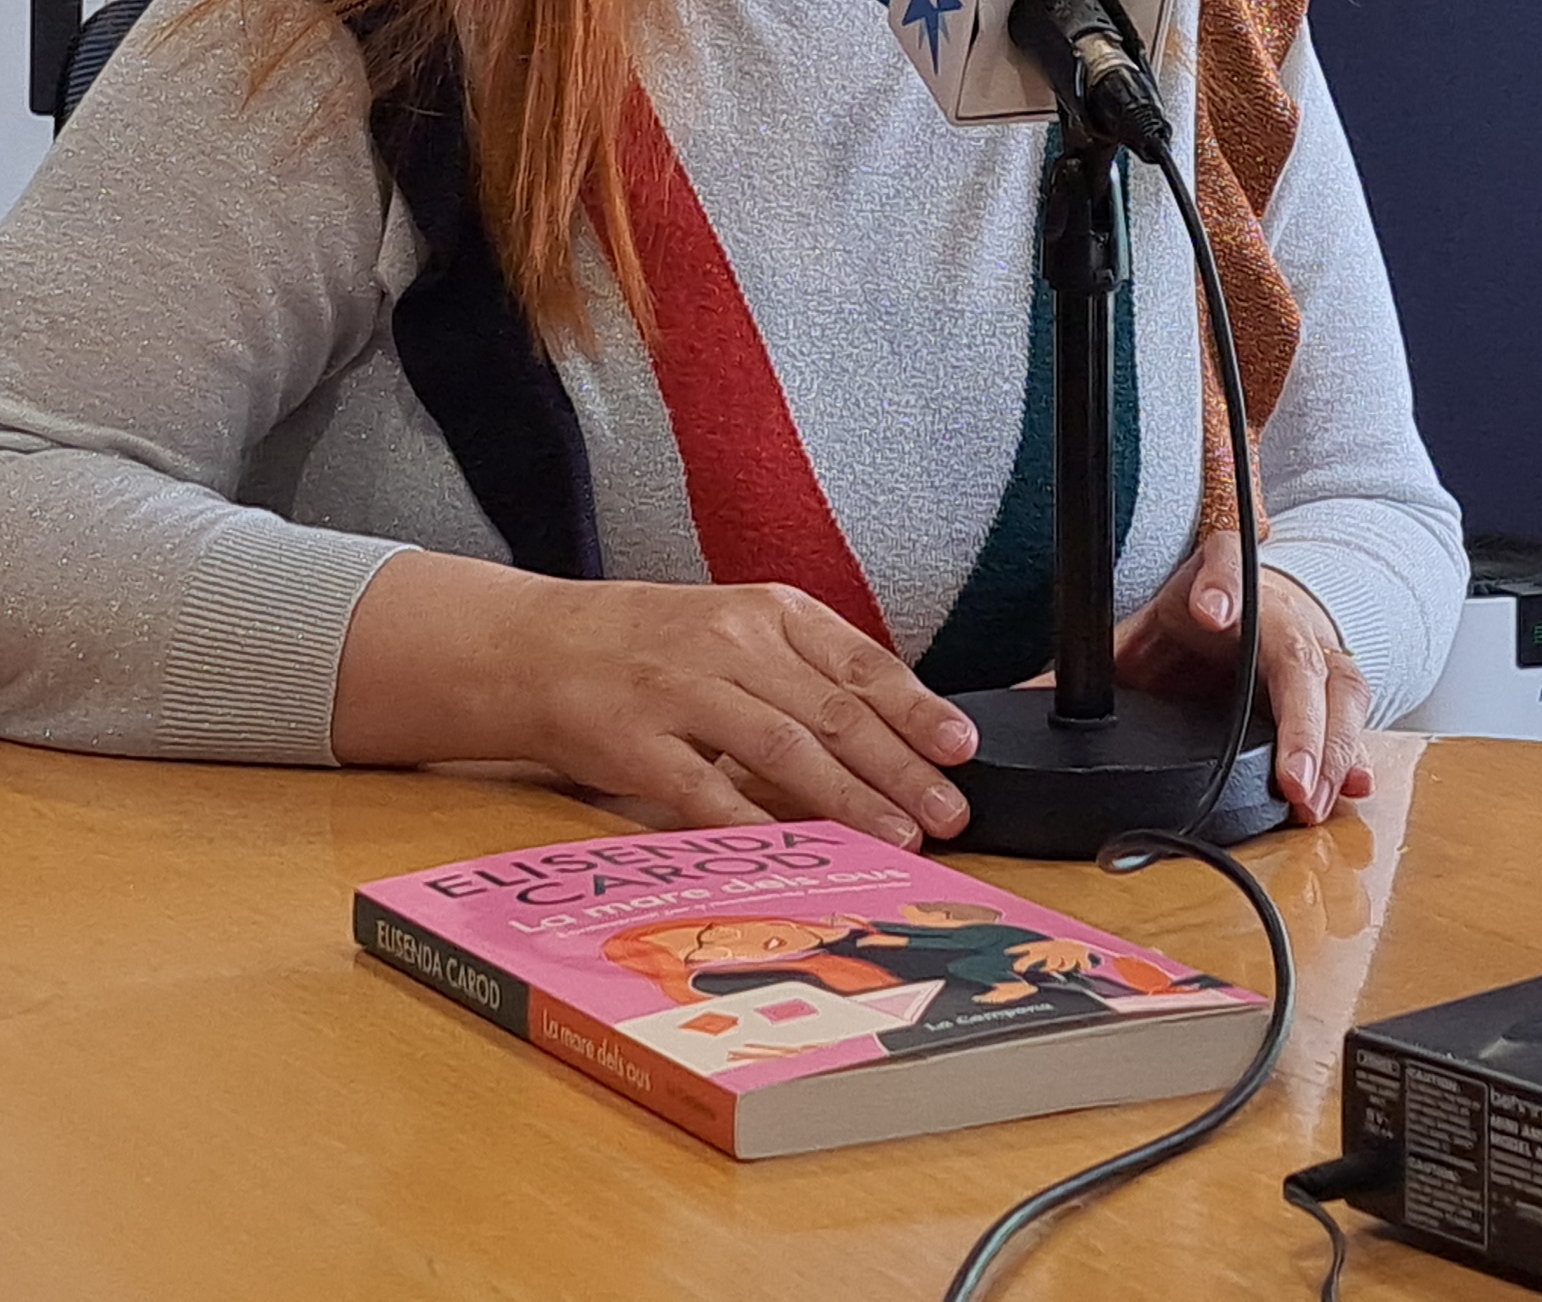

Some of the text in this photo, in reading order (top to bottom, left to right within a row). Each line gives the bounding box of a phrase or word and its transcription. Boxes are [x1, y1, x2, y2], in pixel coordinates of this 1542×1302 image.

[424, 831, 846, 898] ELISENDA
[516, 852, 831, 906] CAROD
[509, 868, 911, 934] La mare dels ous
[376, 919, 502, 1010] ELISENDA CAROD
[543, 1008, 652, 1092] La mare dels ous
